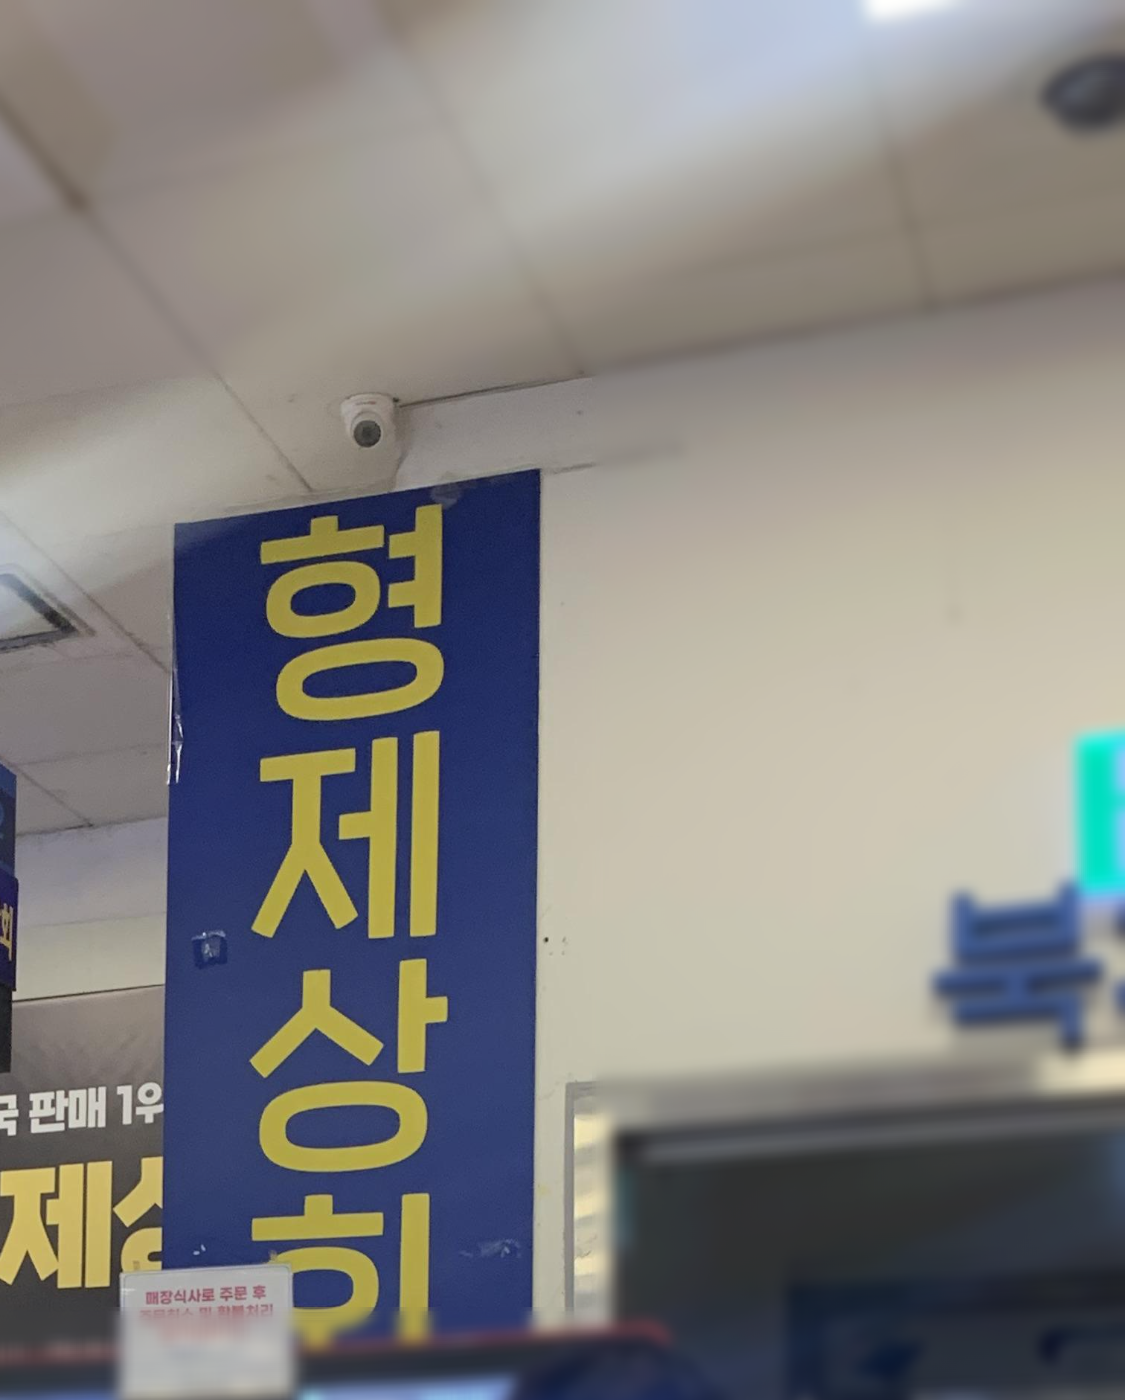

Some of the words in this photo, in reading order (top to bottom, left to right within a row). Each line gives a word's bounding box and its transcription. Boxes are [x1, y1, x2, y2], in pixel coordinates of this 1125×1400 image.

[249, 503, 449, 1346] 형제상회
[29, 1087, 107, 1134] 판매
[145, 1288, 216, 1306] 매장식사로
[220, 1286, 248, 1301] 주문
[253, 1285, 267, 1300] 후
